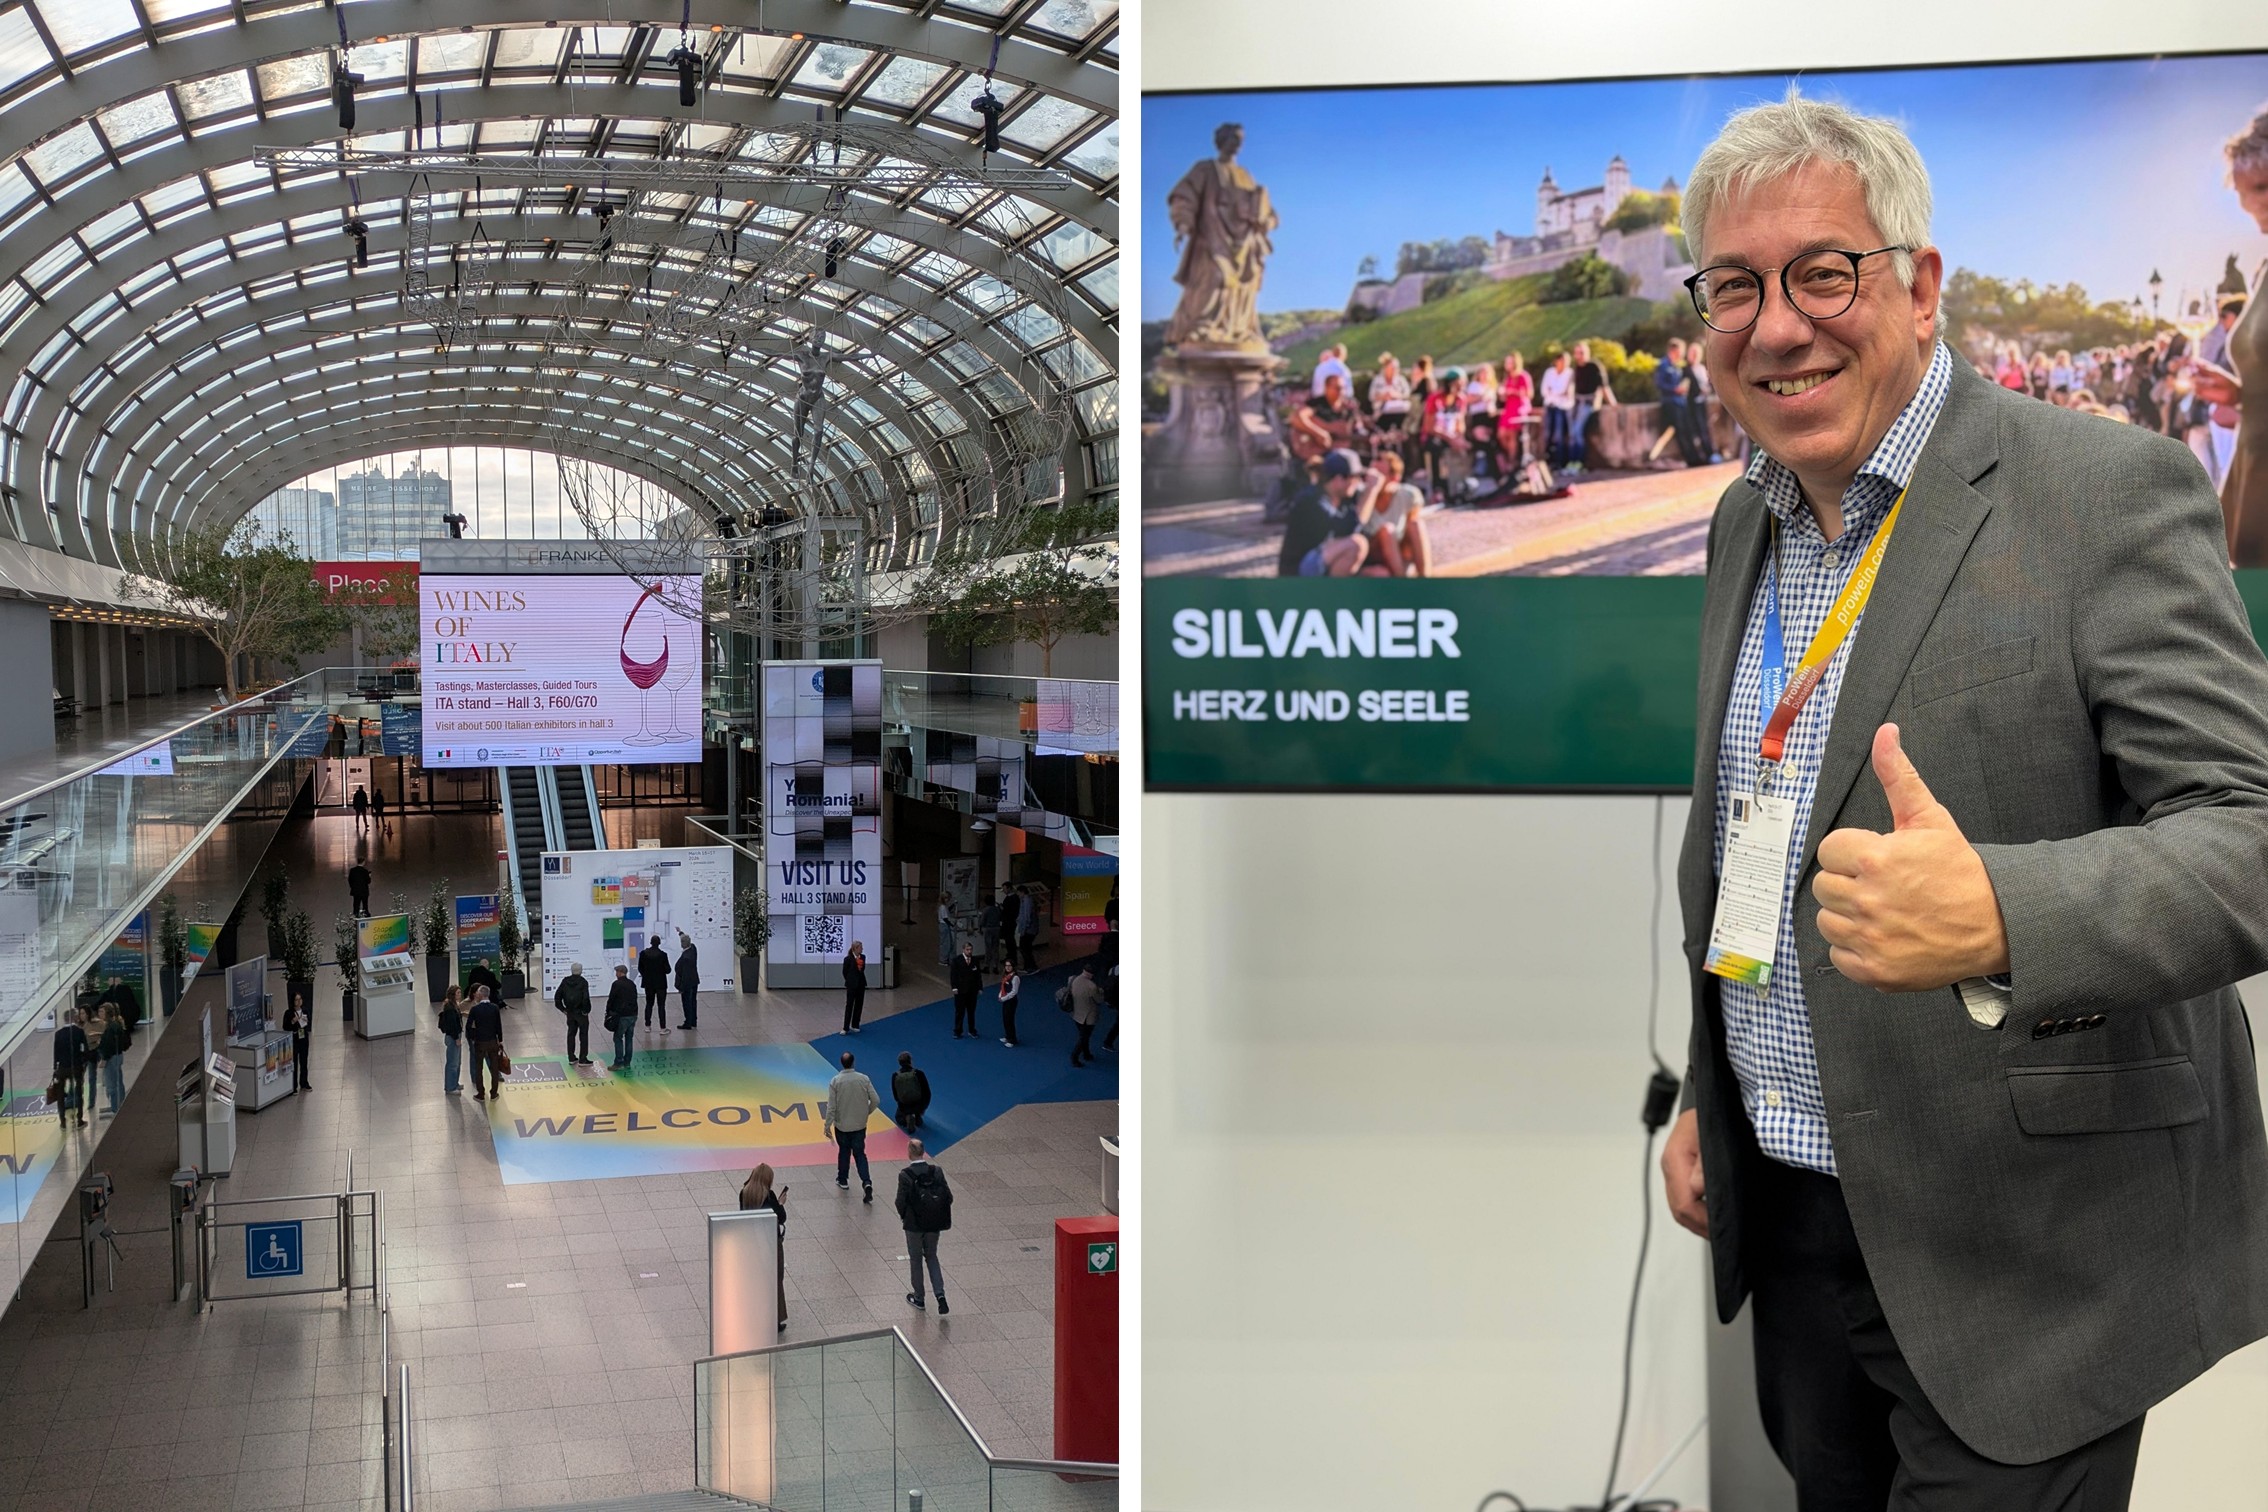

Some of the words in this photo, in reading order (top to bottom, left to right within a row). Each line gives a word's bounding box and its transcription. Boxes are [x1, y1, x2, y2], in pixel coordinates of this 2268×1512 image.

[539, 550, 609, 562] FRANKE
[329, 574, 390, 594] Place
[1837, 534, 1891, 626] prowein.com
[433, 590, 526, 611] WINES
[434, 616, 473, 637] OF
[1171, 608, 1462, 658] SILVANER
[435, 642, 518, 663] ITALY
[434, 681, 474, 693] Tastings,
[476, 680, 541, 692] Masterclasses,
[543, 680, 572, 691] Guided
[574, 680, 598, 690] Tours
[1763, 668, 1772, 710] Düsseldorf
[1783, 665, 1812, 706] ProWein
[1792, 669, 1820, 710] Düsseldorf
[435, 697, 454, 710] ITA
[458, 697, 491, 709] stand
[507, 696, 529, 709] Hall
[533, 696, 545, 711] 3,
[548, 695, 598, 709] F60/G70
[1173, 690, 1268, 721] HERZ
[1275, 690, 1351, 722] UND
[1357, 690, 1470, 722] SEELE
[435, 720, 455, 731] Visit
[457, 720, 483, 731] about
[485, 720, 502, 730] 500
[504, 720, 532, 730] Italian
[534, 719, 577, 730] exhibitors
[579, 719, 587, 729] in
[589, 719, 605, 729] hall
[607, 718, 614, 728] 3
[786, 793, 864, 806] Romania!
[781, 860, 834, 886] VISIT
[840, 860, 867, 886] US
[1065, 861, 1084, 870] New
[1086, 859, 1110, 870] World
[781, 892, 805, 904] HALL
[807, 892, 813, 904] 3
[815, 892, 846, 904] STAND
[848, 892, 867, 904] A50
[1065, 891, 1090, 902] Spain
[1065, 921, 1097, 931] Greece
[504, 1080, 615, 1092] Düsseldorf
[506, 1075, 564, 1084] ProWein
